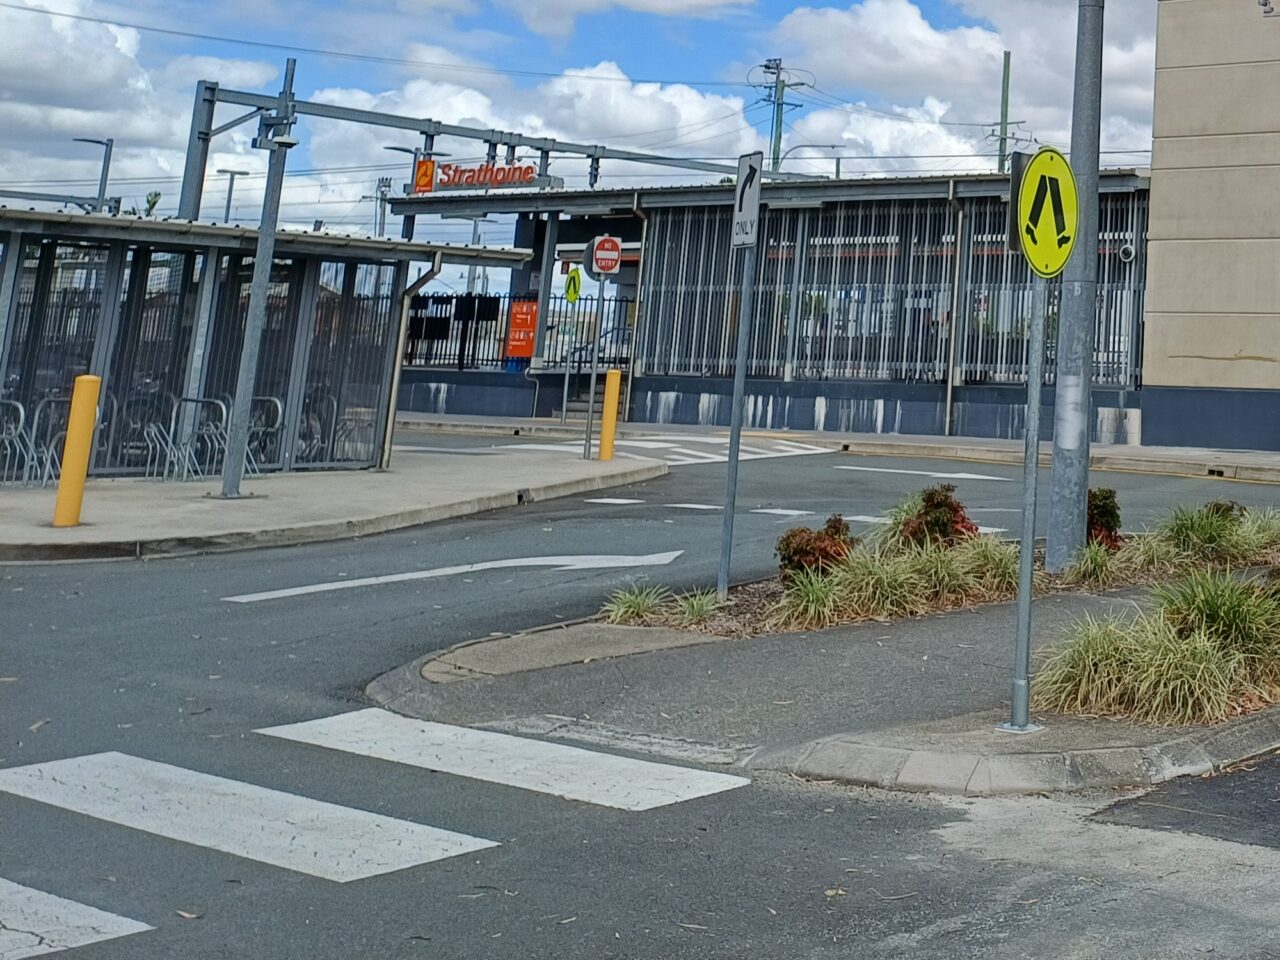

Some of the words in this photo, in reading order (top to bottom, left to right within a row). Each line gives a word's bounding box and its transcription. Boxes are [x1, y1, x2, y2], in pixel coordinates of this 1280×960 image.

[439, 161, 535, 187] Strathpine
[735, 220, 755, 236] ONLY
[598, 259, 616, 267] ENTRY
